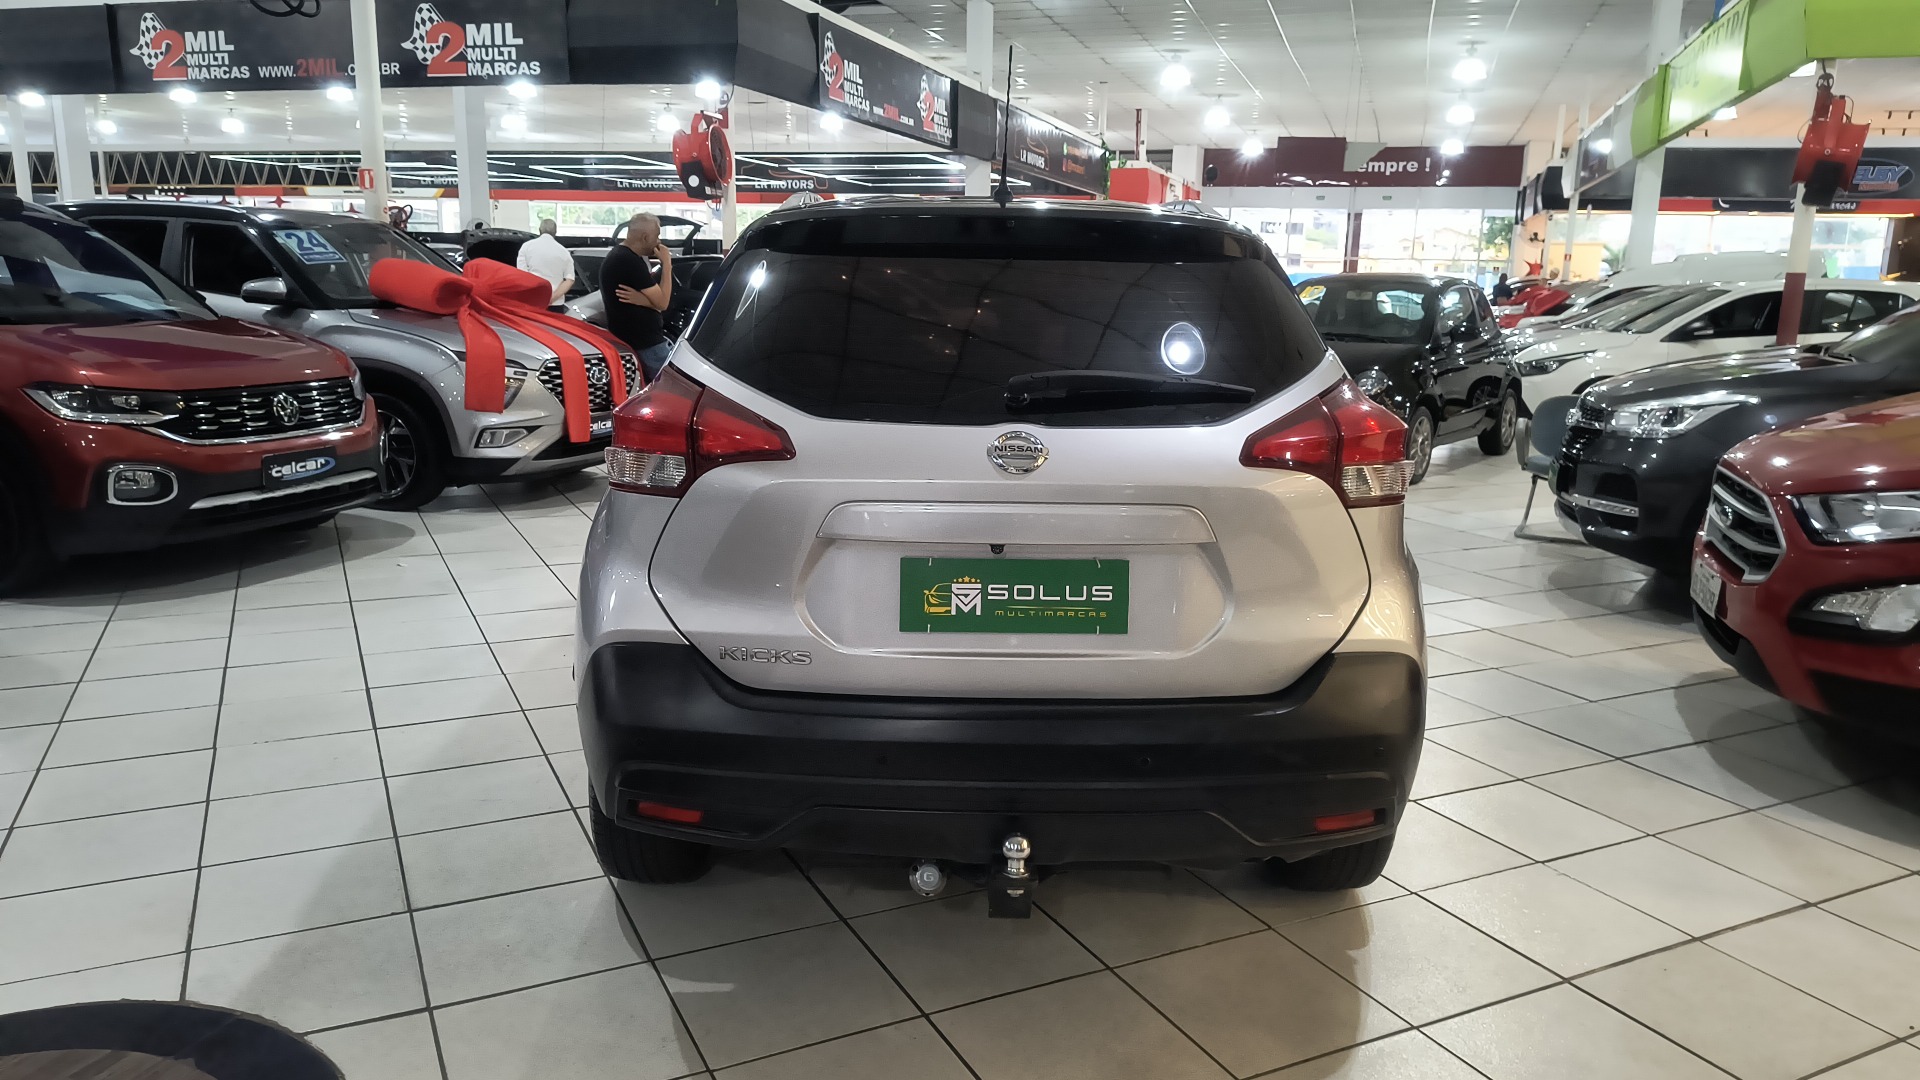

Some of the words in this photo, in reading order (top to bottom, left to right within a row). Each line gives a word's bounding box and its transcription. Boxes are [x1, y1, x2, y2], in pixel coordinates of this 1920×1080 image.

[151, 29, 187, 80] 2
[184, 30, 234, 52] MIL
[426, 21, 467, 77] 2
[465, 22, 523, 46] MIL
[467, 47, 517, 61] MULTI
[186, 53, 229, 66] MULTI
[187, 66, 250, 80] MARCAS
[467, 61, 541, 77] MARCAS
[829, 51, 844, 102] 2
[844, 59, 862, 84] MIL
[844, 80, 864, 98] MULTI
[844, 93, 870, 112] MARCAS
[934, 96, 948, 116] MIL
[1357, 161, 1418, 176] empre
[632, 178, 674, 189] MOTORS
[770, 179, 815, 190] MOTORS
[284, 230, 330, 252] 24
[994, 445, 1043, 454] NISSAN
[987, 584, 1113, 602] SOLUS
[994, 610, 1107, 618] MULTIMARCAS
[719, 646, 812, 665] KICKS
